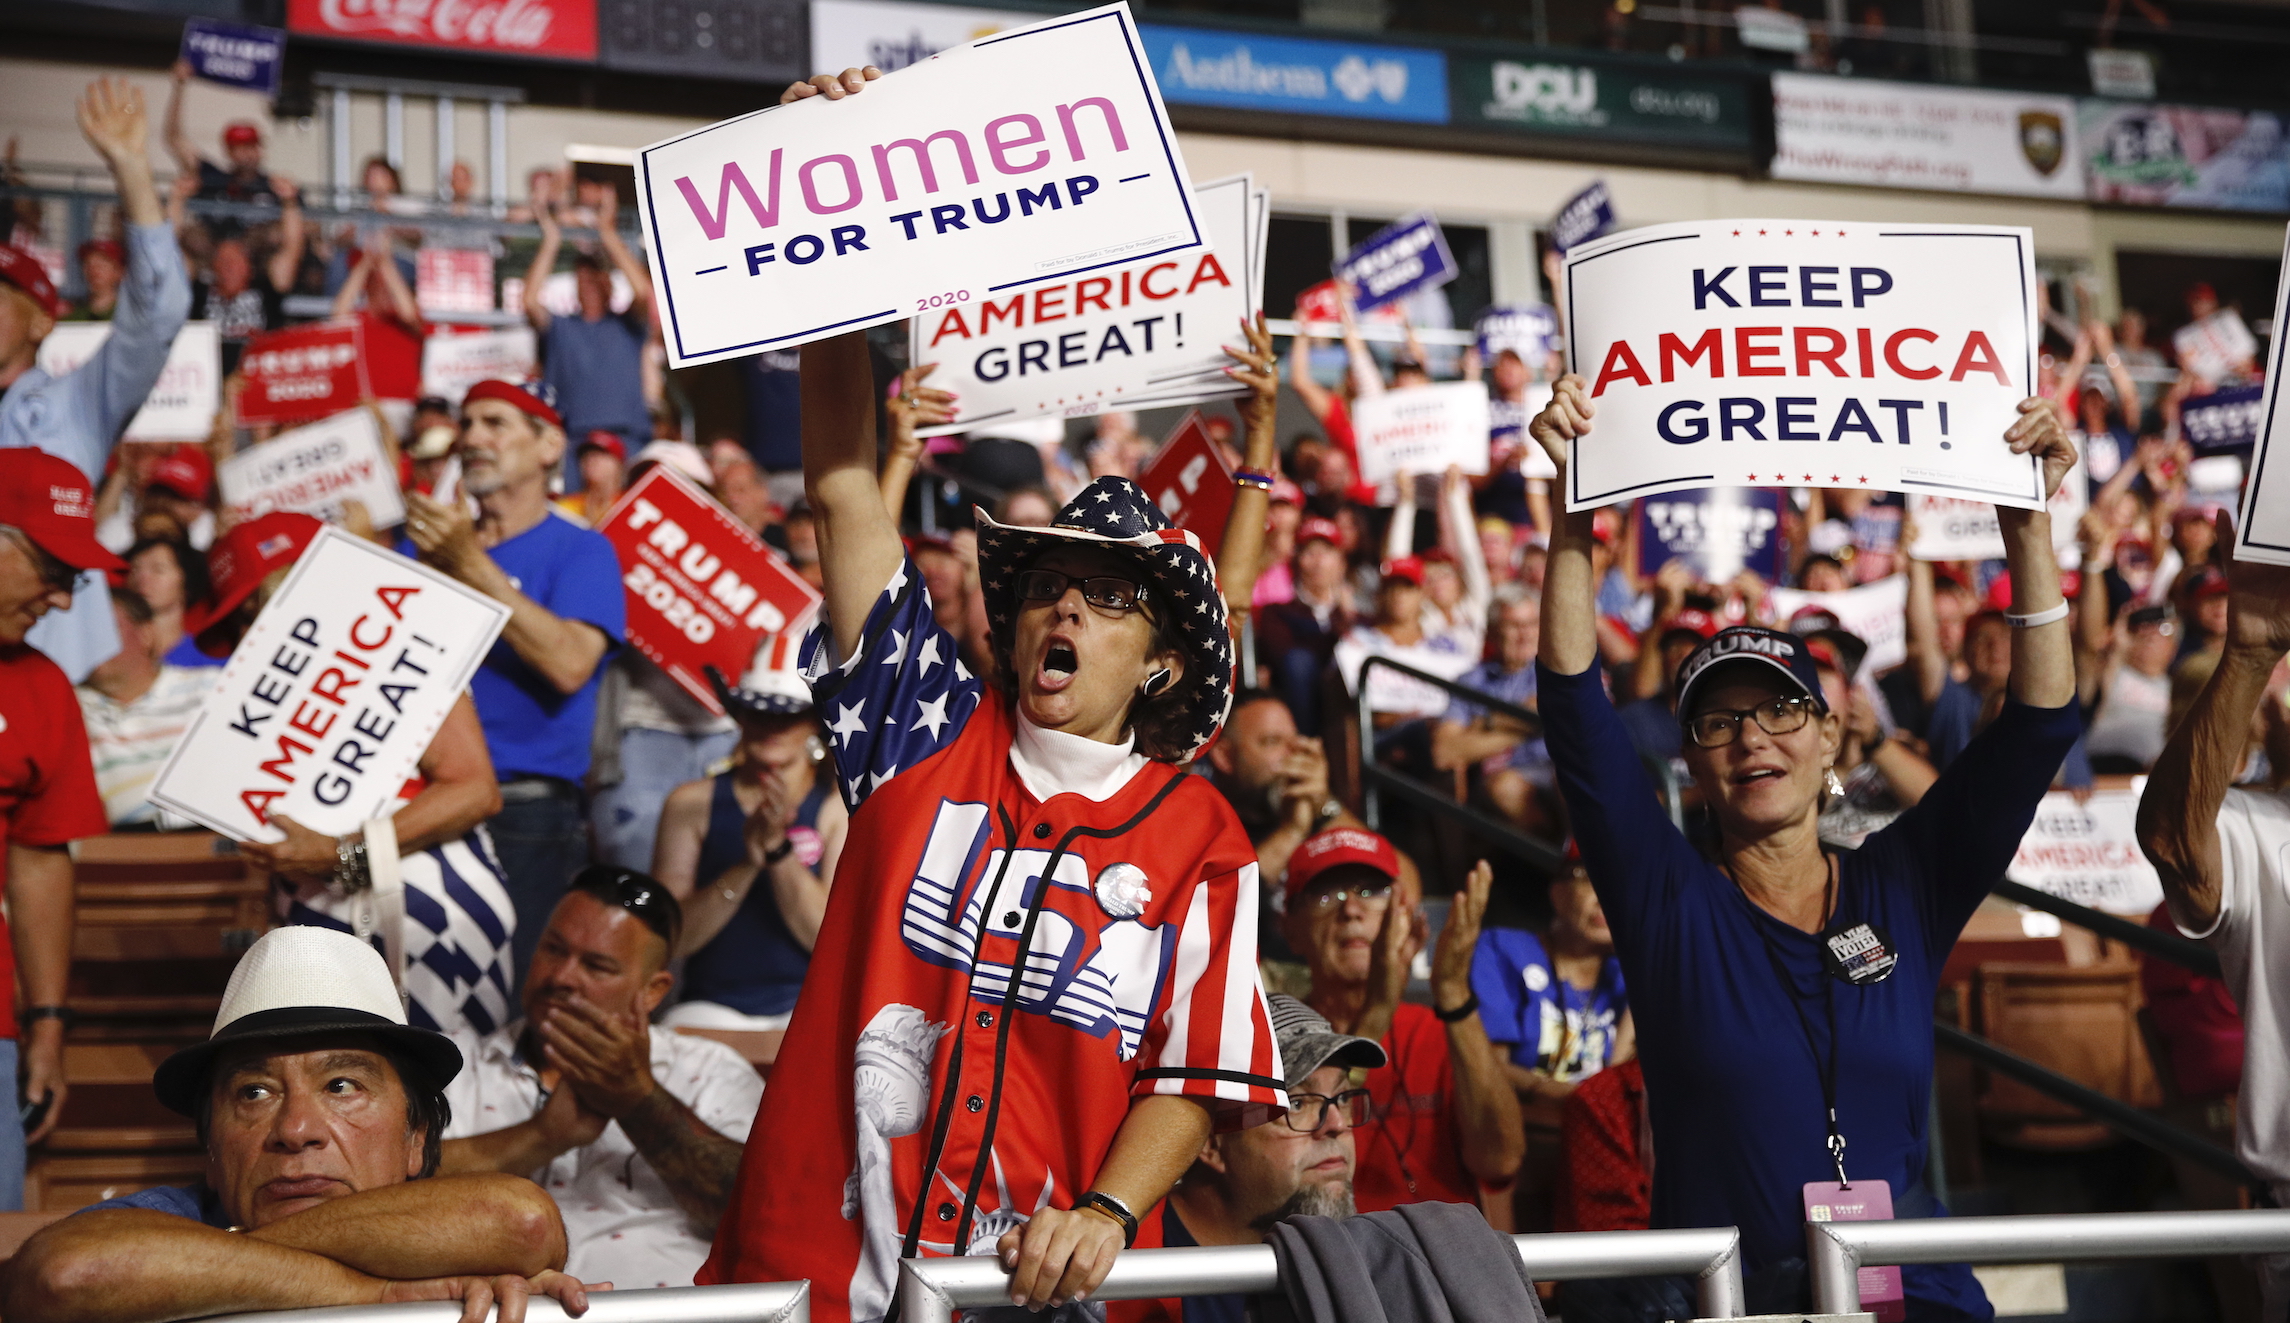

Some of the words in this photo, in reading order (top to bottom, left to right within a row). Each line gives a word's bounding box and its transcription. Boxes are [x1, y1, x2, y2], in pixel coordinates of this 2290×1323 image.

[1491, 61, 1598, 114] DCU
[673, 97, 1130, 240] Women
[743, 224, 870, 277] FOR
[889, 175, 1100, 240] TRUMP
[916, 289, 971, 312] 2020
[930, 253, 1232, 348] AMERICA
[1692, 266, 1894, 310] KEEP
[974, 312, 1185, 383] GREAT!
[1590, 326, 2013, 399] AMERICA
[1656, 397, 1953, 451] GREAT!
[623, 563, 715, 644] 2020
[627, 497, 786, 634] TRUMP
[229, 617, 322, 739] KEEP
[1682, 634, 1795, 681] TRUMP
[239, 586, 424, 826] AMERICA
[312, 633, 446, 806] GREAT!
[899, 795, 1178, 1062] USA
[1838, 933, 1879, 958] VOTED
